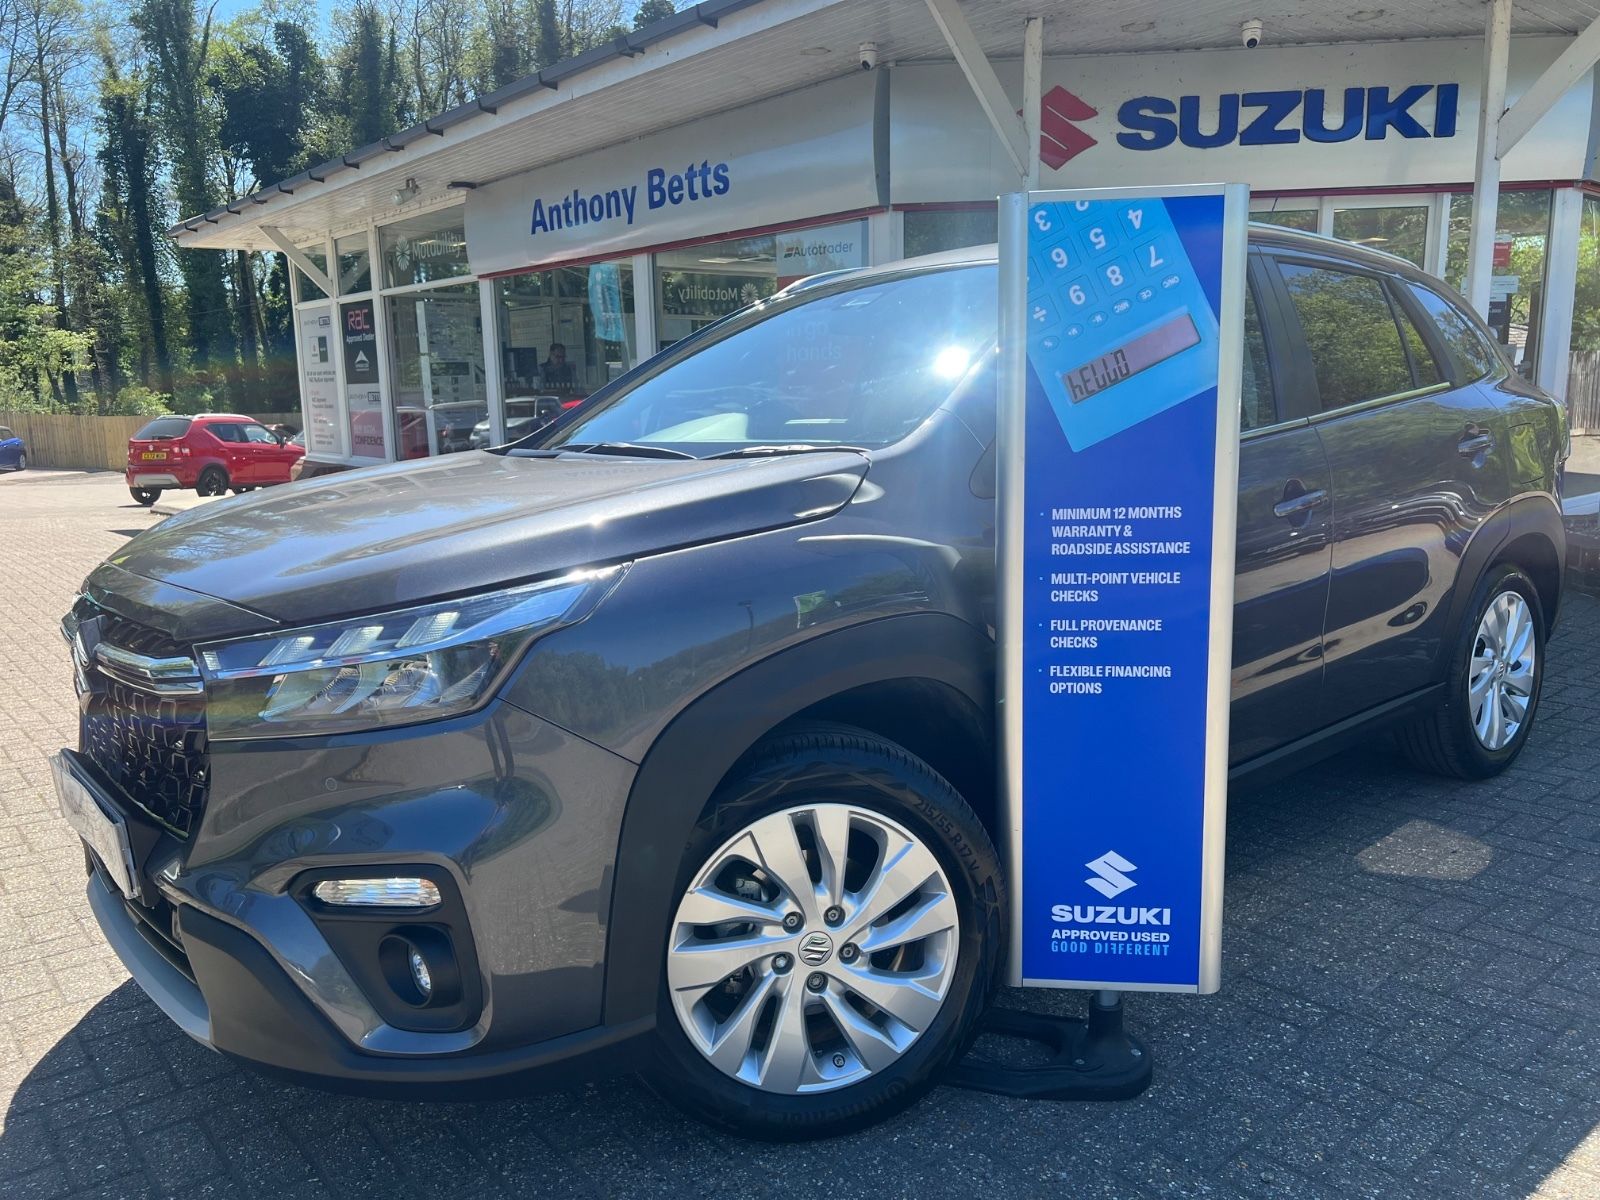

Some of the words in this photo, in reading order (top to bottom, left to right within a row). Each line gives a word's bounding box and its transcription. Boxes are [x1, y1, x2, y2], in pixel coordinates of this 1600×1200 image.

[1116, 83, 1460, 151] SUZUKI
[531, 185, 637, 235] Anthony
[647, 160, 730, 210] Betts
[412, 231, 460, 261] Motability
[793, 241, 853, 258] Autotrader
[1052, 508, 1111, 520] MINIMUM
[1113, 507, 1126, 519] 12
[1128, 506, 1182, 519] MONTHS
[1051, 525, 1121, 537] WARRANTY
[1123, 525, 1133, 537] &
[1051, 543, 1112, 555] ROADSIDE
[1113, 542, 1190, 554] ASSISTANCE
[1051, 573, 1128, 585] MULTI-POINT
[1130, 572, 1181, 584] VEHICLE
[1051, 590, 1099, 602] CHECKS
[1050, 619, 1079, 631] FULL
[1080, 619, 1162, 631] PROVENANCE
[1050, 636, 1098, 648] CHECKS
[1050, 665, 1103, 677] FLEXIBLE
[1105, 666, 1171, 678] FINANCING
[1049, 682, 1103, 694] OPTIONS
[914, 798, 954, 835] 215/55
[1051, 904, 1171, 926] SUZUKI
[1051, 929, 1129, 941] APPROVED
[1131, 932, 1170, 943] USED
[1051, 940, 1088, 953] GOOD
[1094, 942, 1170, 956] DIFFERENT
